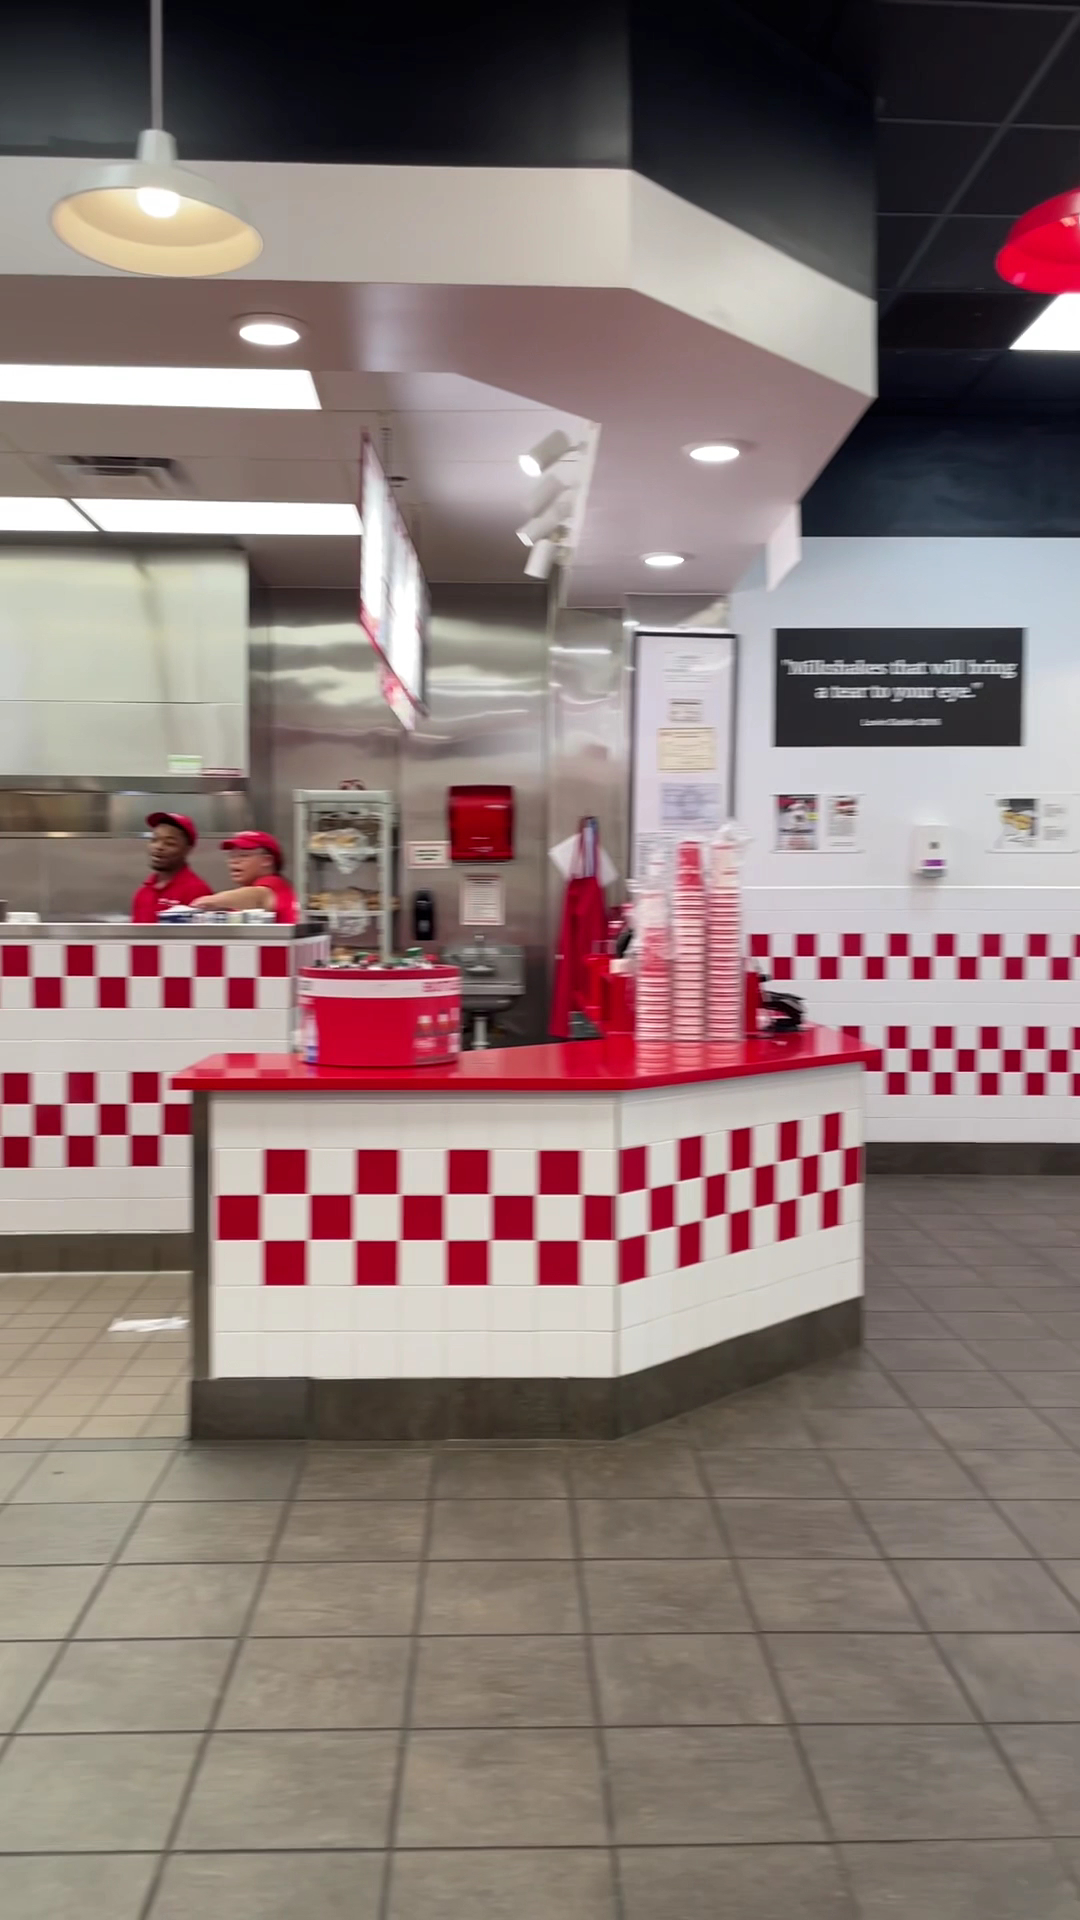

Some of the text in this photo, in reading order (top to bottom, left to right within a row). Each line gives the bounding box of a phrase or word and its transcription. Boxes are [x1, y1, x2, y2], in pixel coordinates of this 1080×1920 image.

[781, 659, 1018, 679] "Milkshakes that will bring
[814, 687, 829, 699] a
[829, 685, 869, 698] tear
[869, 685, 892, 698] to
[890, 687, 935, 702] your
